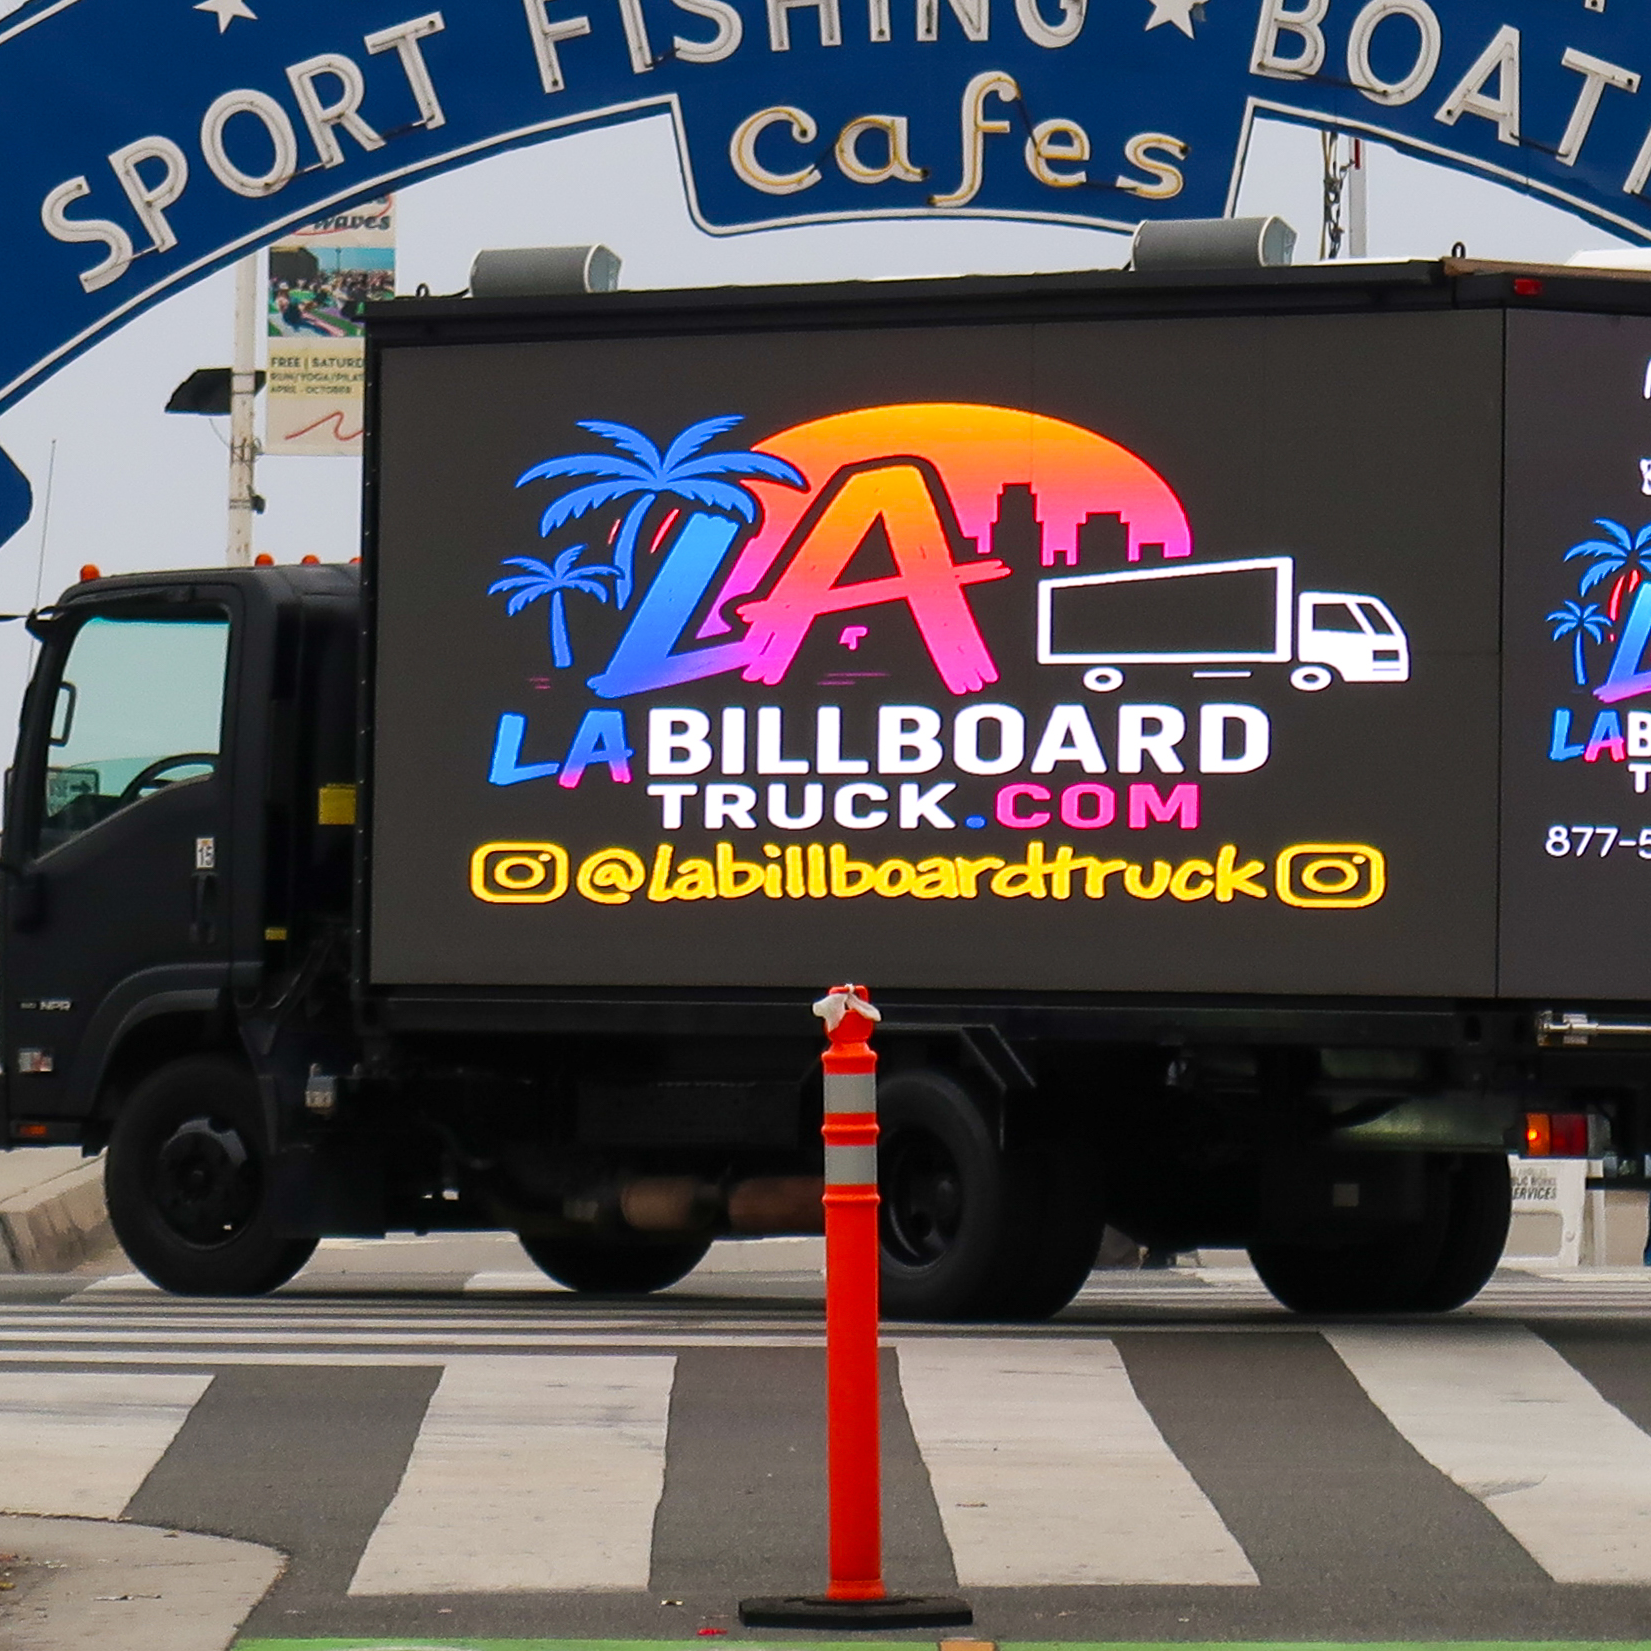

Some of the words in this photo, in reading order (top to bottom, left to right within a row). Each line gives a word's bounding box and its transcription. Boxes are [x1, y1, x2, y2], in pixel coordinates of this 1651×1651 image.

[40, 11, 450, 293] SPORT
[728, 71, 1188, 210] cafes
[270, 357, 300, 368] FREE
[587, 464, 1010, 697] LA
[648, 782, 1200, 831] TRUCK.COM
[578, 840, 1268, 904] @labillboardtruck
